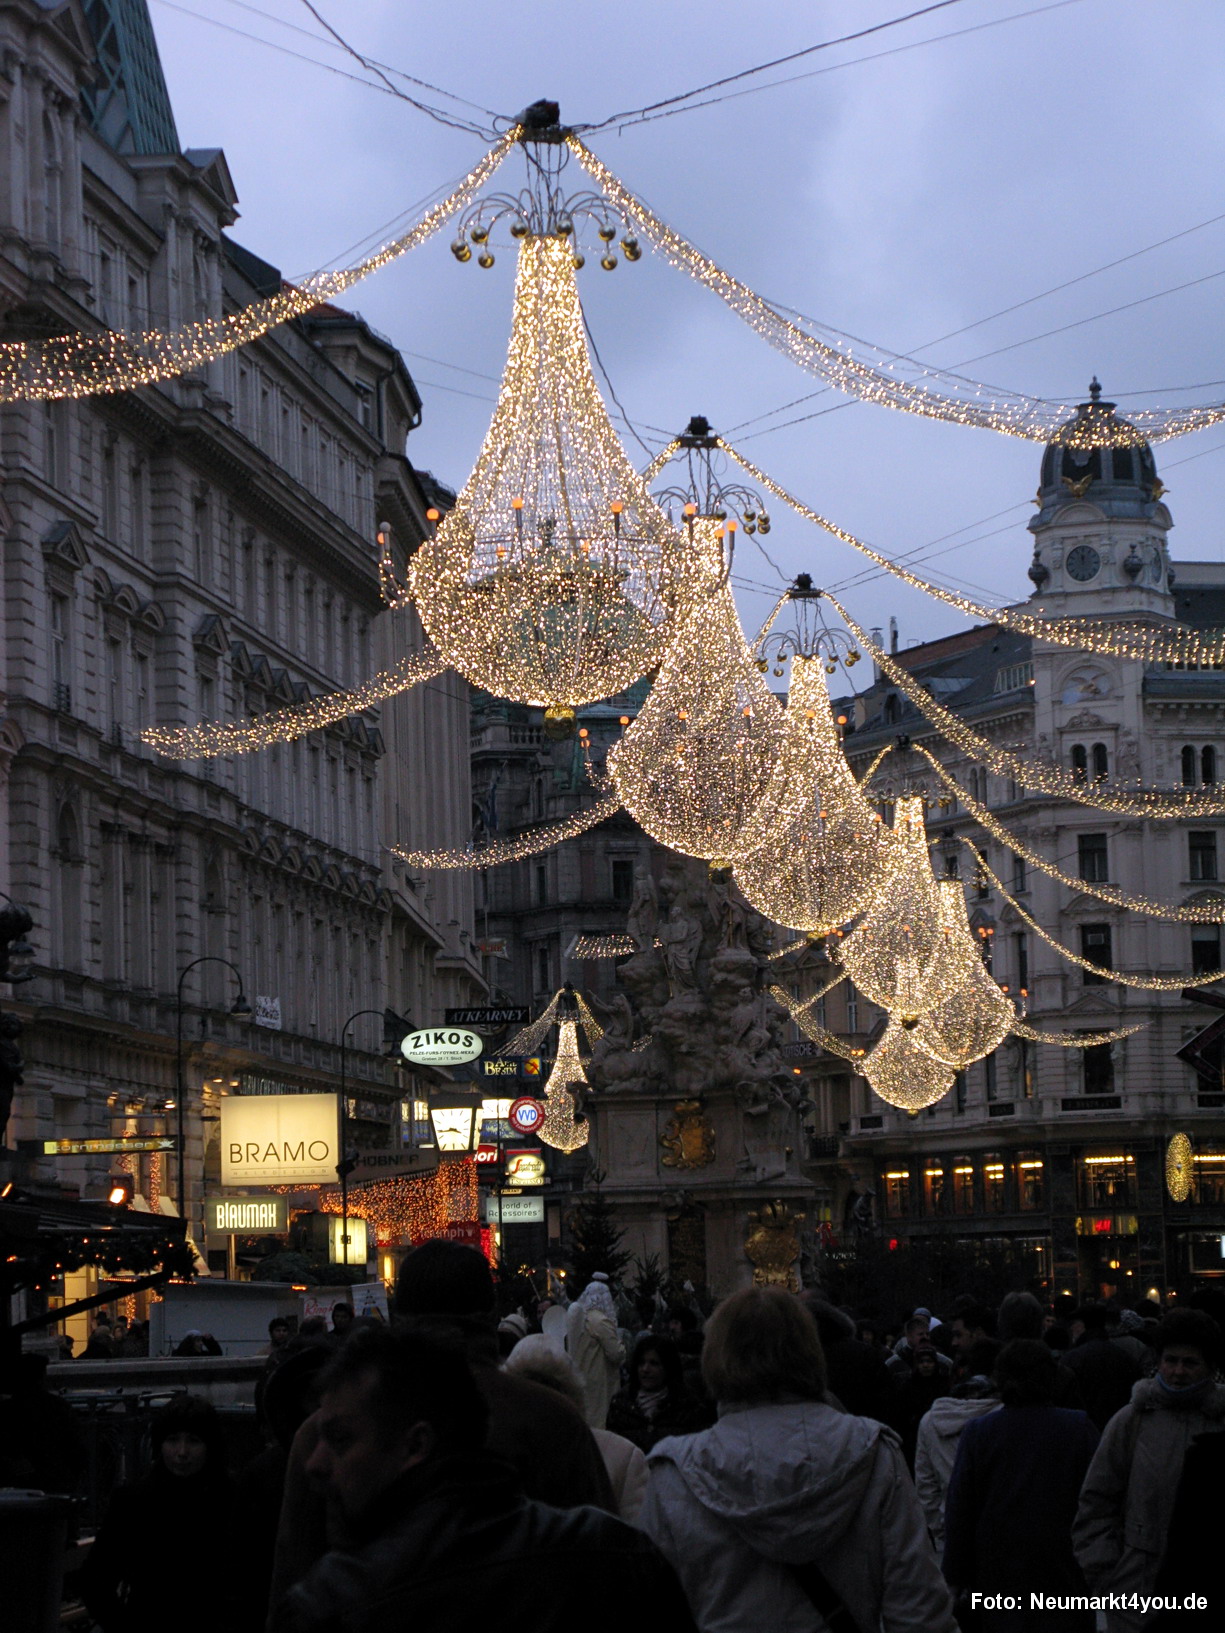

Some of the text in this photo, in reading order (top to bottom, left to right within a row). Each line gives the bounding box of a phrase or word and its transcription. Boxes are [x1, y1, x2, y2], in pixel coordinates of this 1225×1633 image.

[410, 1031, 475, 1049] ZIKOS
[518, 1109, 537, 1121] VVD
[229, 1140, 329, 1163] BRAMO
